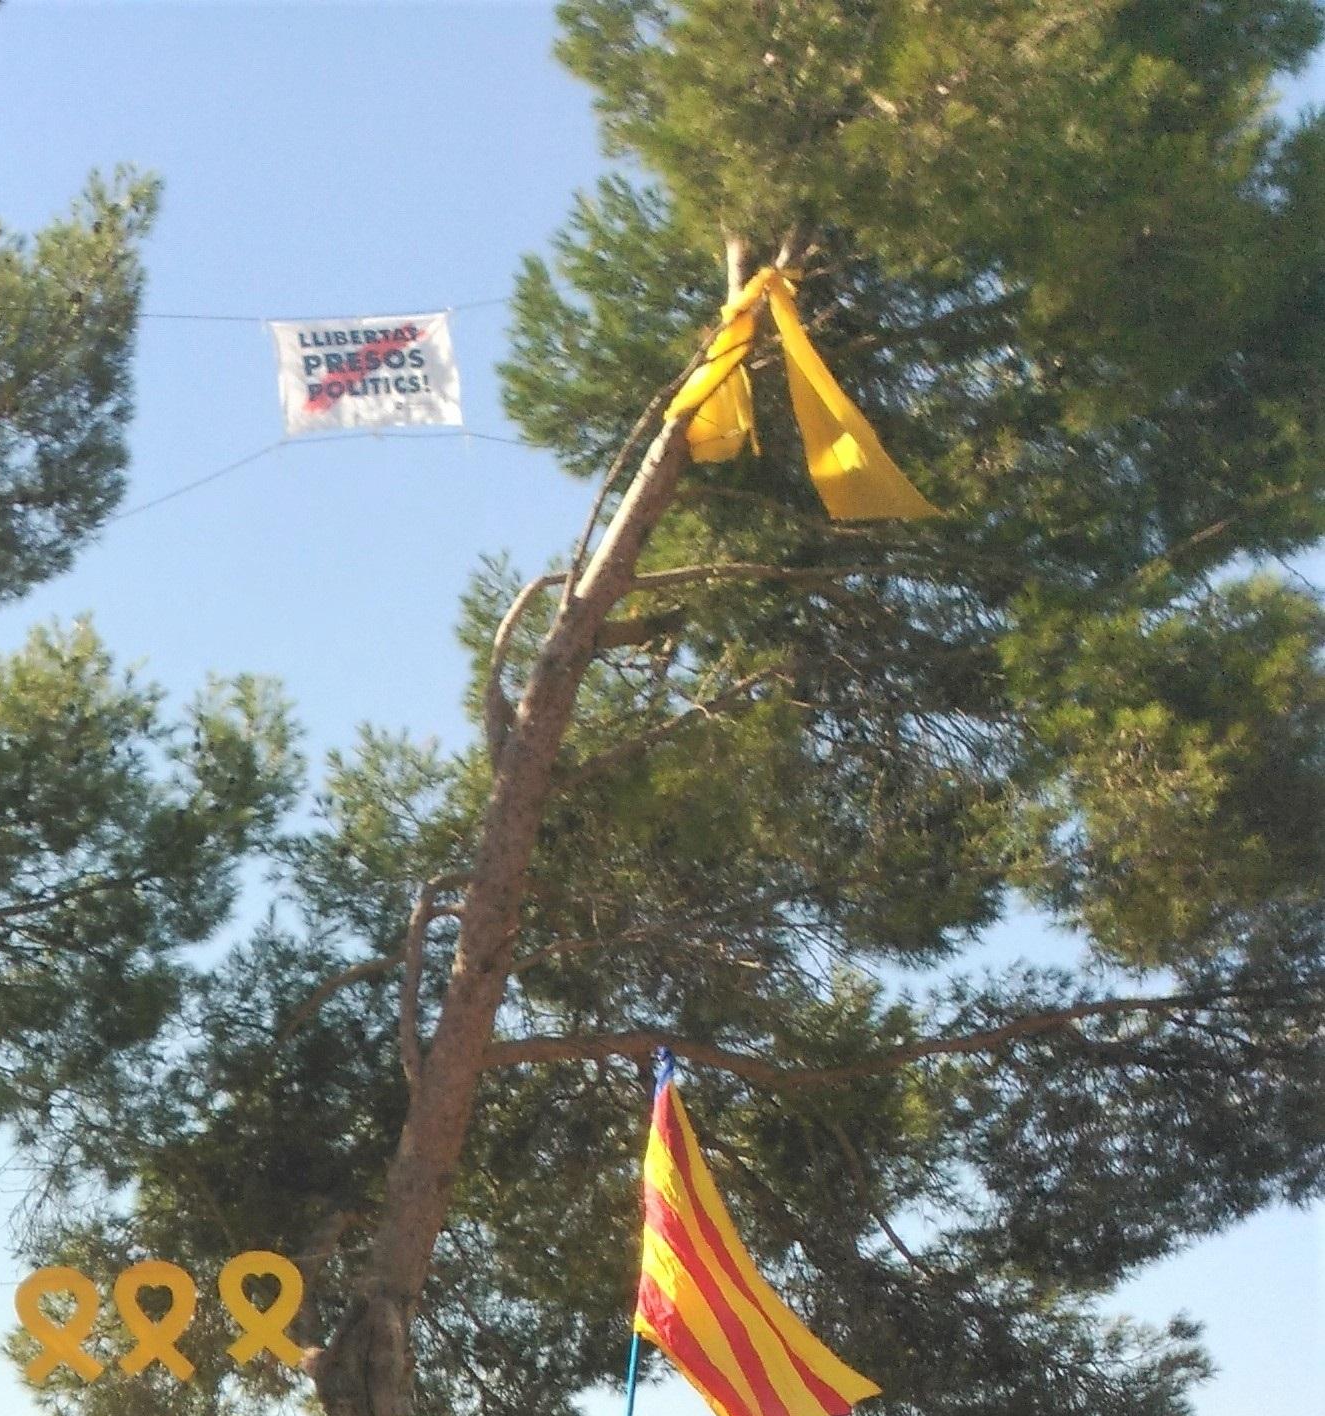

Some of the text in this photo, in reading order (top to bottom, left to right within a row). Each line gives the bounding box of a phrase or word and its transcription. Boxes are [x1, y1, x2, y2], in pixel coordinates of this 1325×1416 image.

[298, 325, 418, 347] LLIBERTAT
[303, 348, 425, 376] PRESOS
[308, 375, 431, 401] POLITICS!
